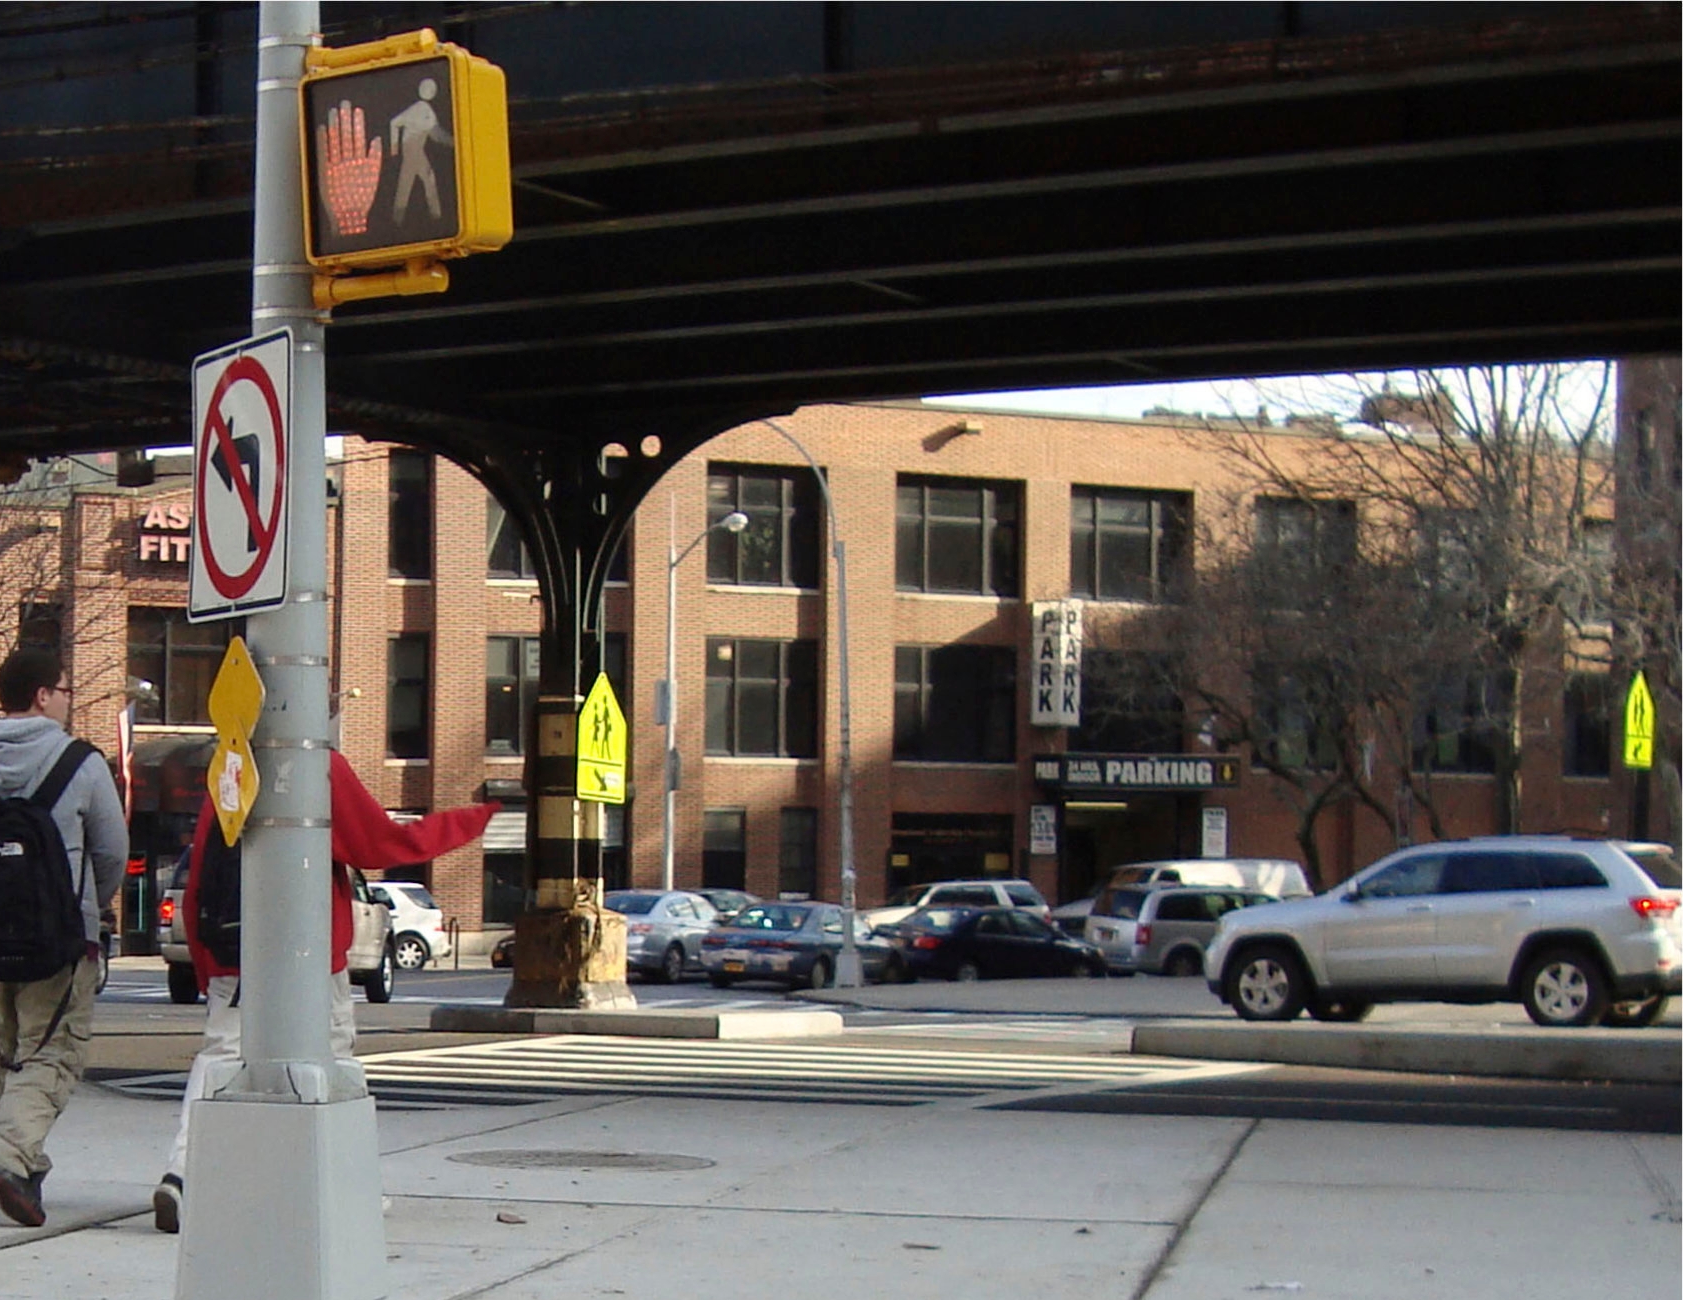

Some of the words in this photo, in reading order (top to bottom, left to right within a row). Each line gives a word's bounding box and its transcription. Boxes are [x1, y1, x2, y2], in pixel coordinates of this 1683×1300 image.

[140, 535, 192, 562] FIT
[1039, 610, 1054, 712] PARK
[1063, 610, 1077, 714] PARK
[1106, 760, 1213, 785] PARKING
